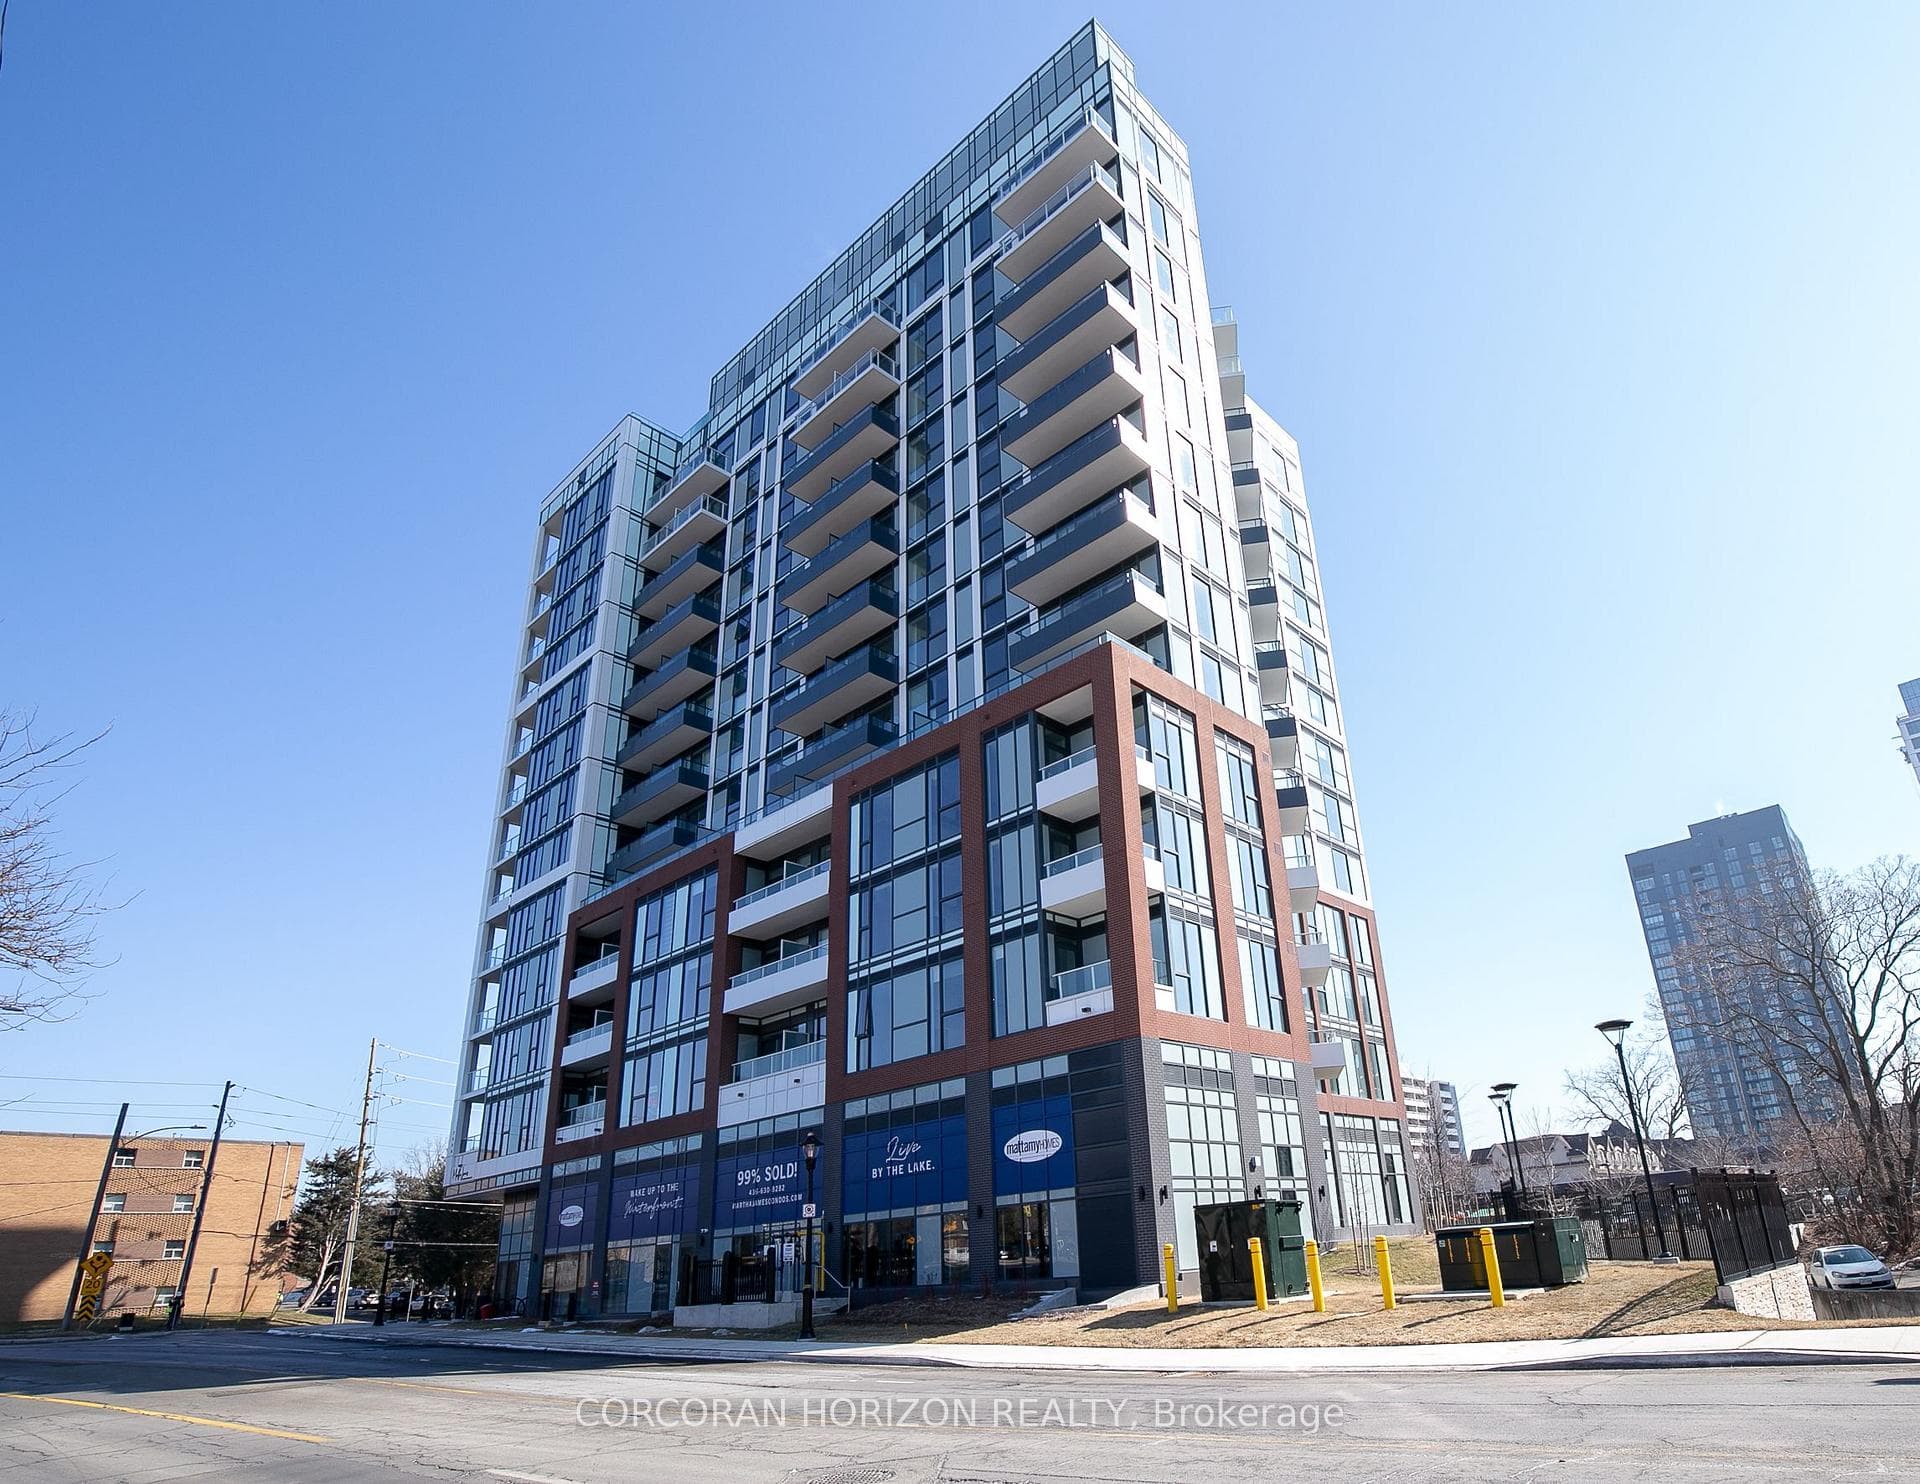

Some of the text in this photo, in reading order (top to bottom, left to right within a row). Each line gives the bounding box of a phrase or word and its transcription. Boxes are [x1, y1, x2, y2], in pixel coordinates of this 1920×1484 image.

[885, 1135, 922, 1163] Live
[737, 1161, 798, 1186] 99% SOLD!
[872, 1159, 935, 1179] BY THE LAKE.
[630, 1182, 680, 1198] WAKE UP TO THE
[85, 1280, 100, 1289] 20
